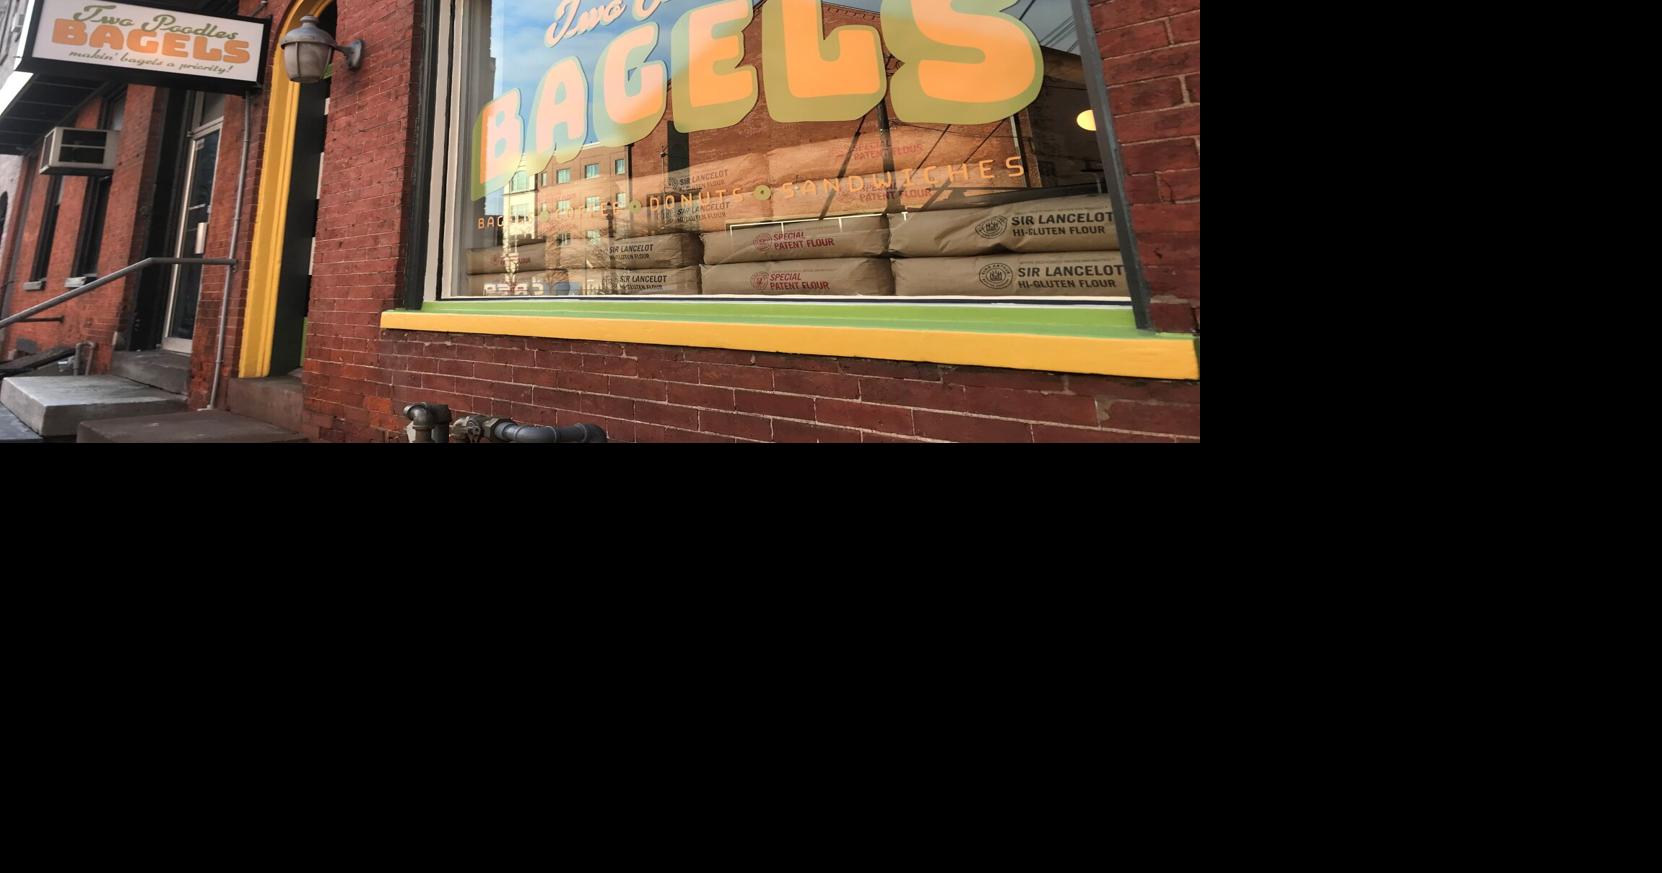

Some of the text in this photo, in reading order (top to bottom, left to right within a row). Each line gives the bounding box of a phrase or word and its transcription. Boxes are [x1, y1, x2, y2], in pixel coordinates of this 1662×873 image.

[73, 5, 239, 40] Two Poodles
[52, 18, 250, 64] BAGELS
[69, 49, 117, 61] makin'
[120, 52, 163, 67] bagels
[179, 62, 234, 74] priority!
[472, 0, 1044, 199] BAGELS
[692, 168, 729, 183] LANCELOT
[650, 187, 744, 212] DONUTS
[781, 156, 1026, 200] SANDWICHES
[1011, 214, 1035, 227] SIR
[1038, 211, 1113, 225] LANCELOT
[773, 231, 806, 241] SPECIAL
[1012, 226, 1067, 237] HI-GLUTEN
[1069, 225, 1106, 235] FLOUR
[609, 243, 654, 254] SIR LANCELOT
[774, 240, 804, 251] PATENT
[806, 237, 835, 248] FLOUR
[769, 273, 802, 281] SPECIAL
[1018, 267, 1040, 278] SIR
[1045, 264, 1125, 277] LANCELOT
[632, 275, 668, 283] LANCELOT
[769, 281, 831, 291] PATENT FLOUR
[1018, 279, 1117, 289] HI-GLUTEN FLOUR
